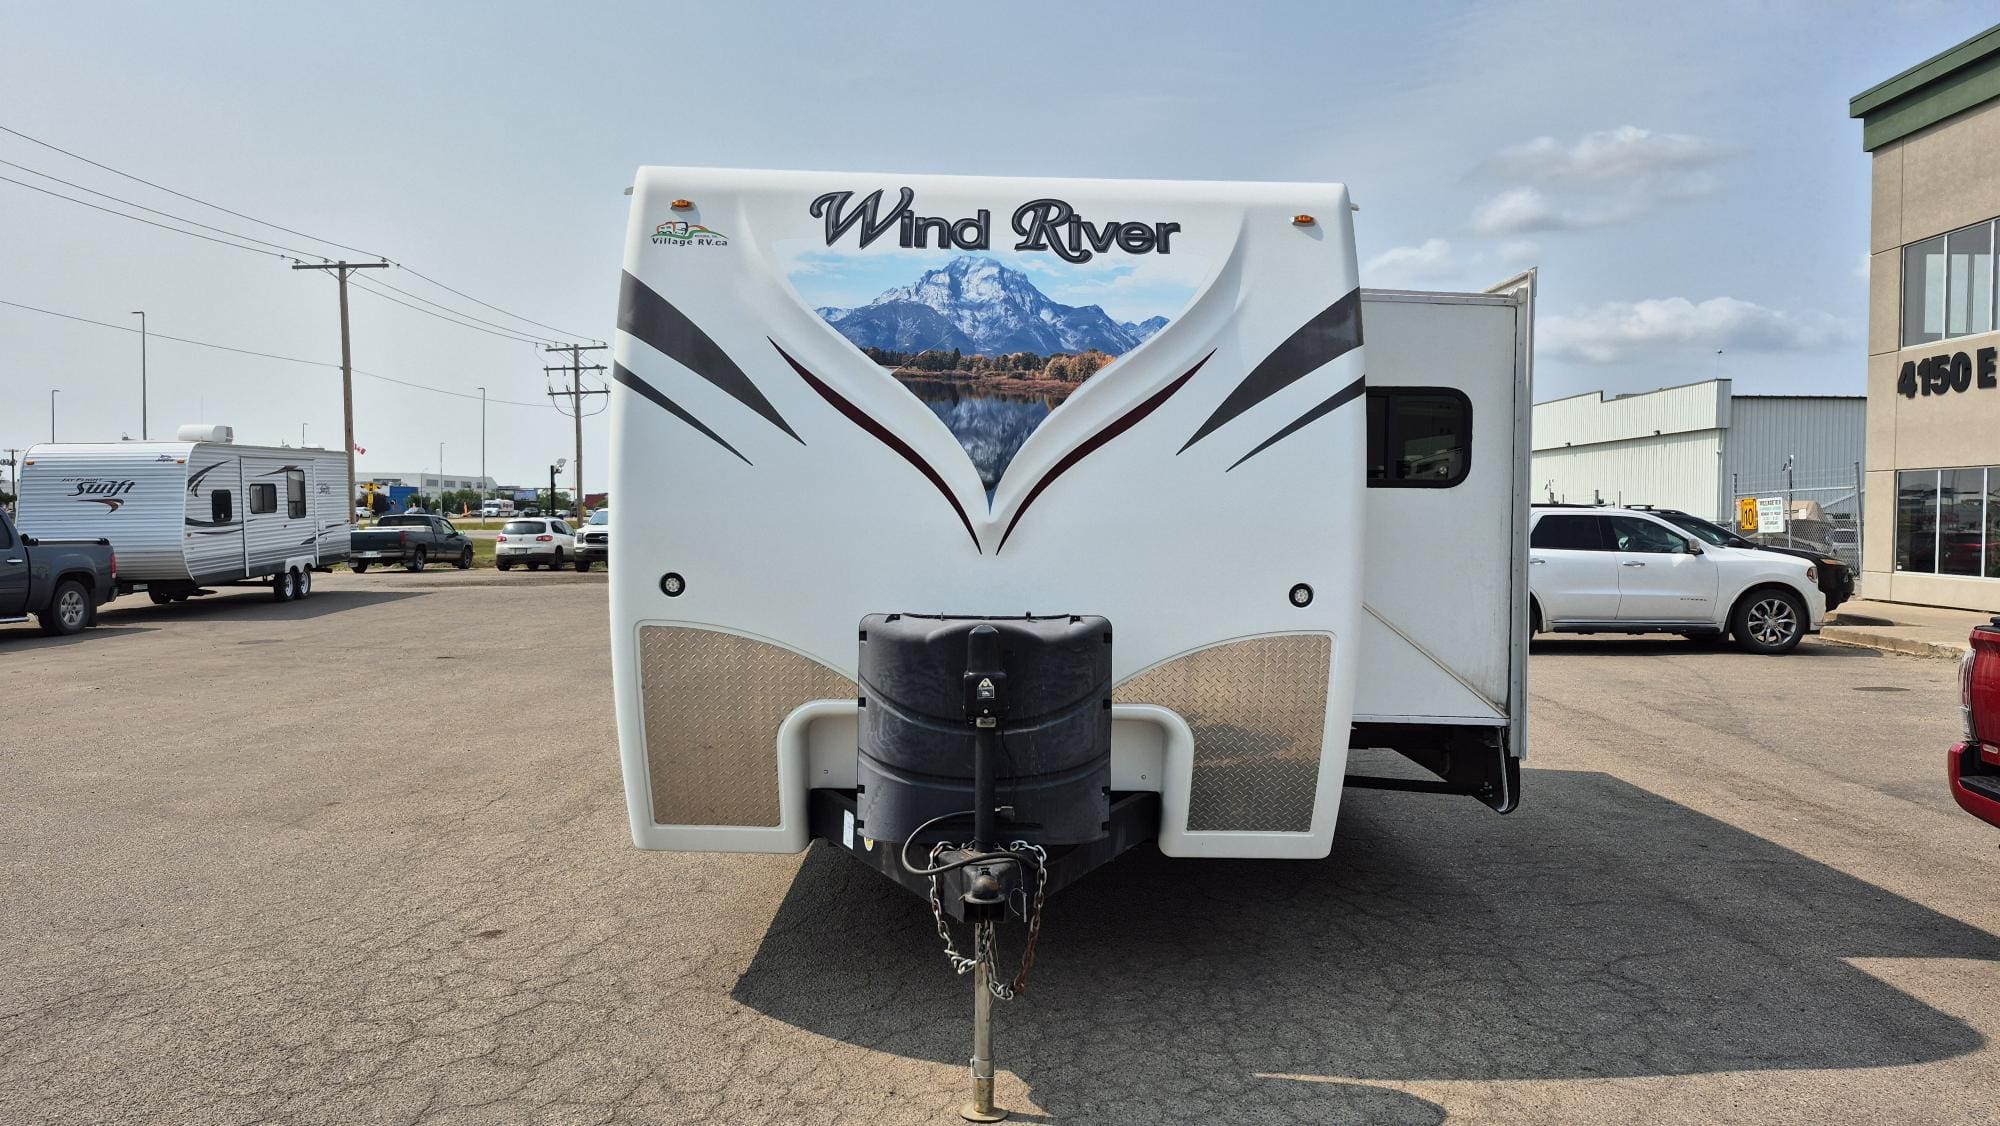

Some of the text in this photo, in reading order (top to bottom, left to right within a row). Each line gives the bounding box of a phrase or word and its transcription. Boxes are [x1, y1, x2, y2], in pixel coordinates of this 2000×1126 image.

[809, 186, 1181, 264] Wind River
[652, 237, 728, 247] Village RV.ca
[1897, 346, 1998, 400] 4150 E
[67, 480, 136, 498] Swift
[1744, 508, 1754, 526] 10
